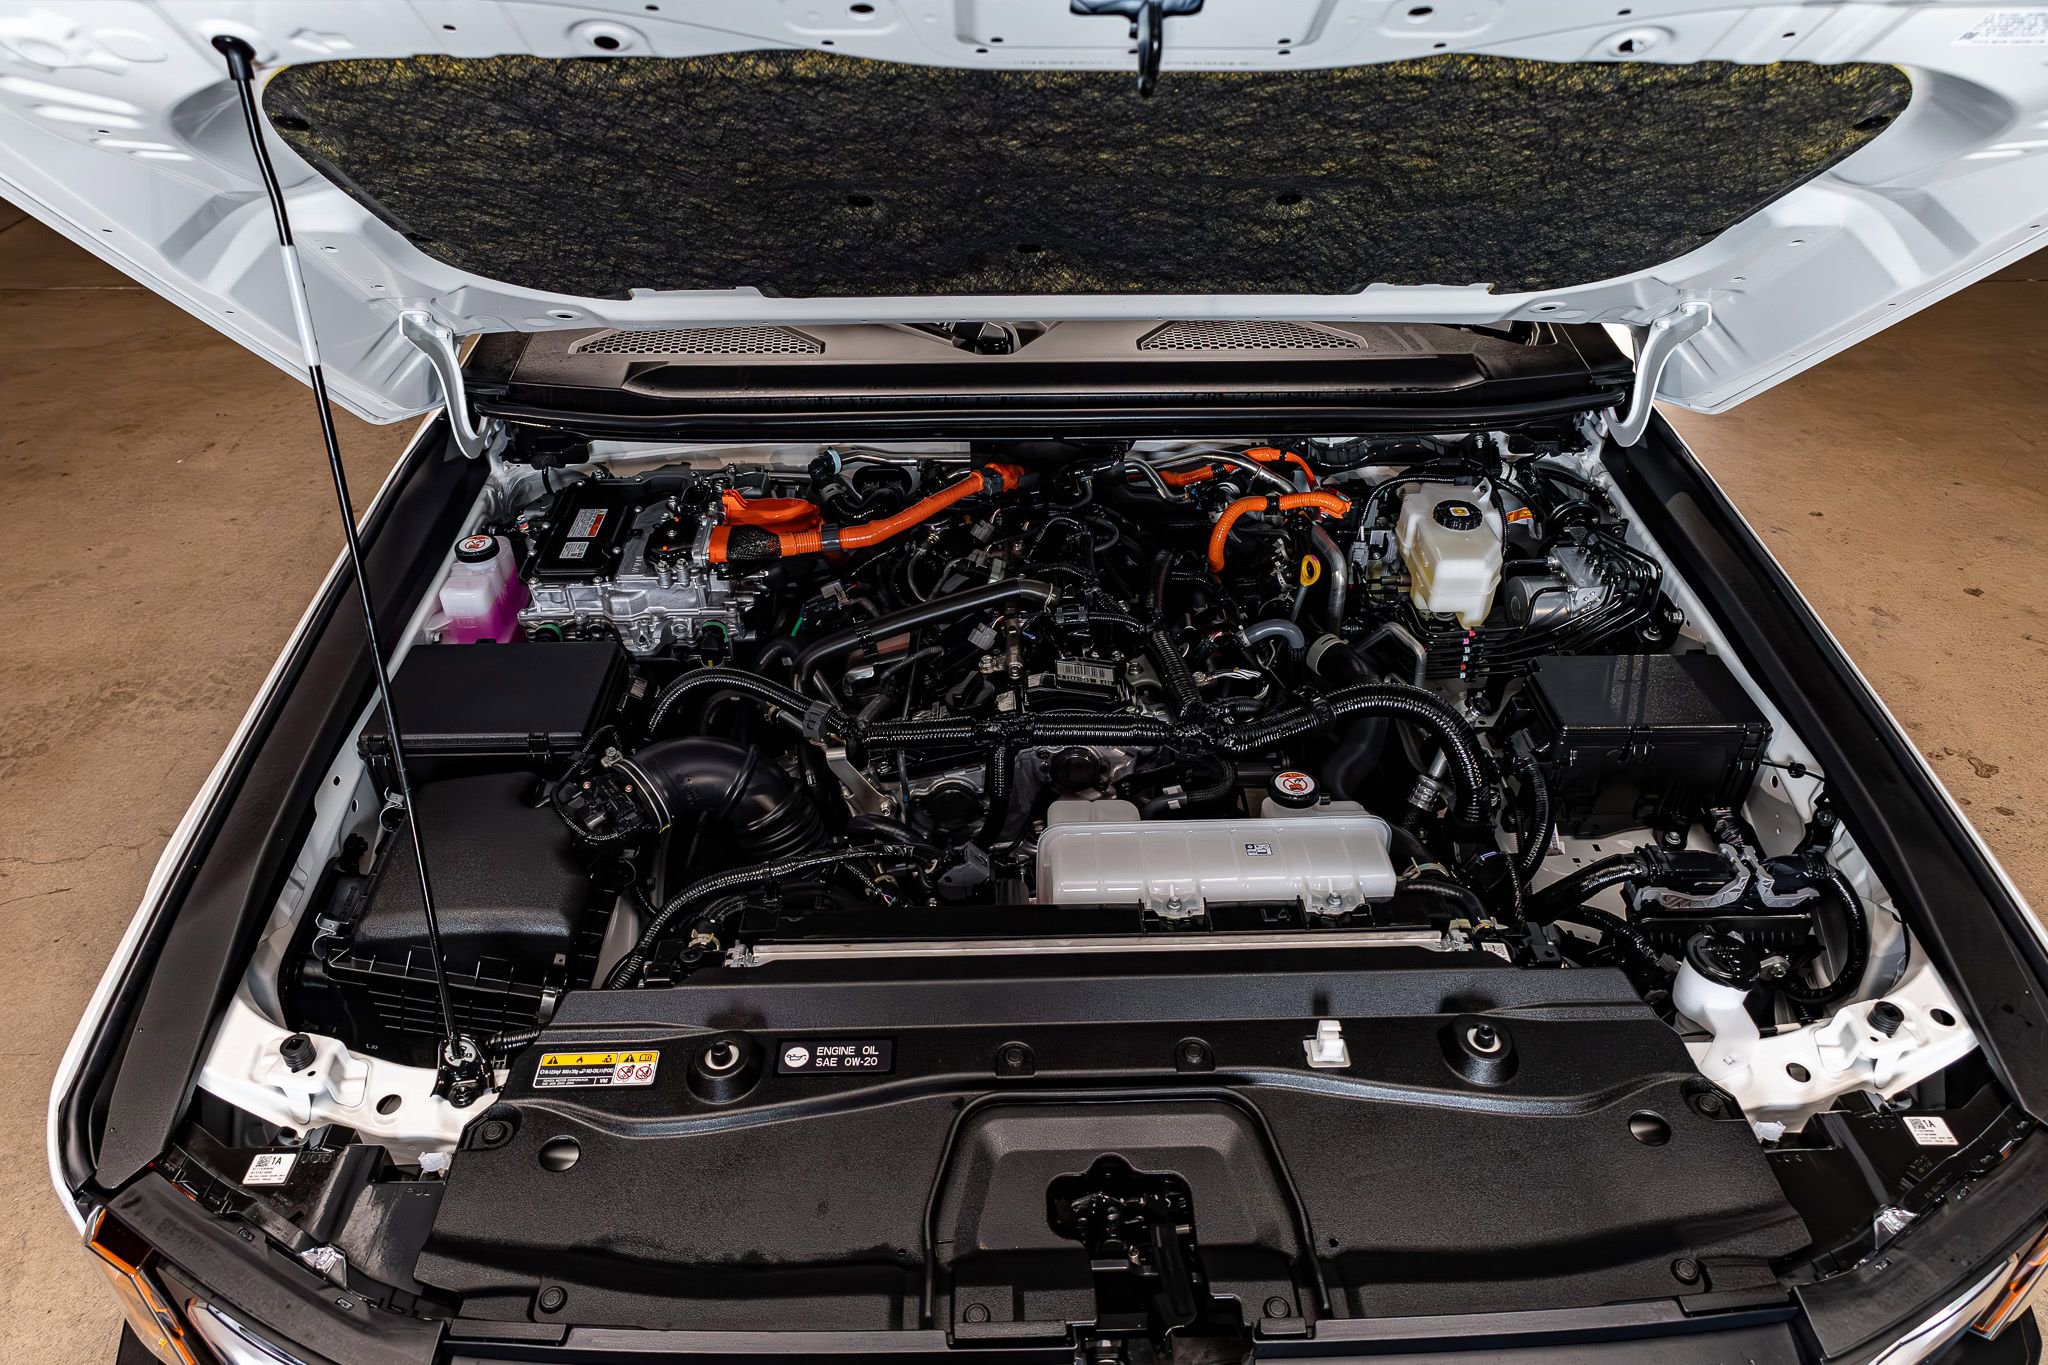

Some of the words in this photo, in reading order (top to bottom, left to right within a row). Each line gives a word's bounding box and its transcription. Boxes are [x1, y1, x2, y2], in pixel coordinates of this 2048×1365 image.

[816, 1046, 856, 1056] ENGINE
[862, 1045, 879, 1055] OIL
[815, 1057, 838, 1067] SAE
[844, 1056, 878, 1066] 0W-20
[1922, 1119, 1936, 1128] 1A
[271, 1156, 282, 1165] 1A
